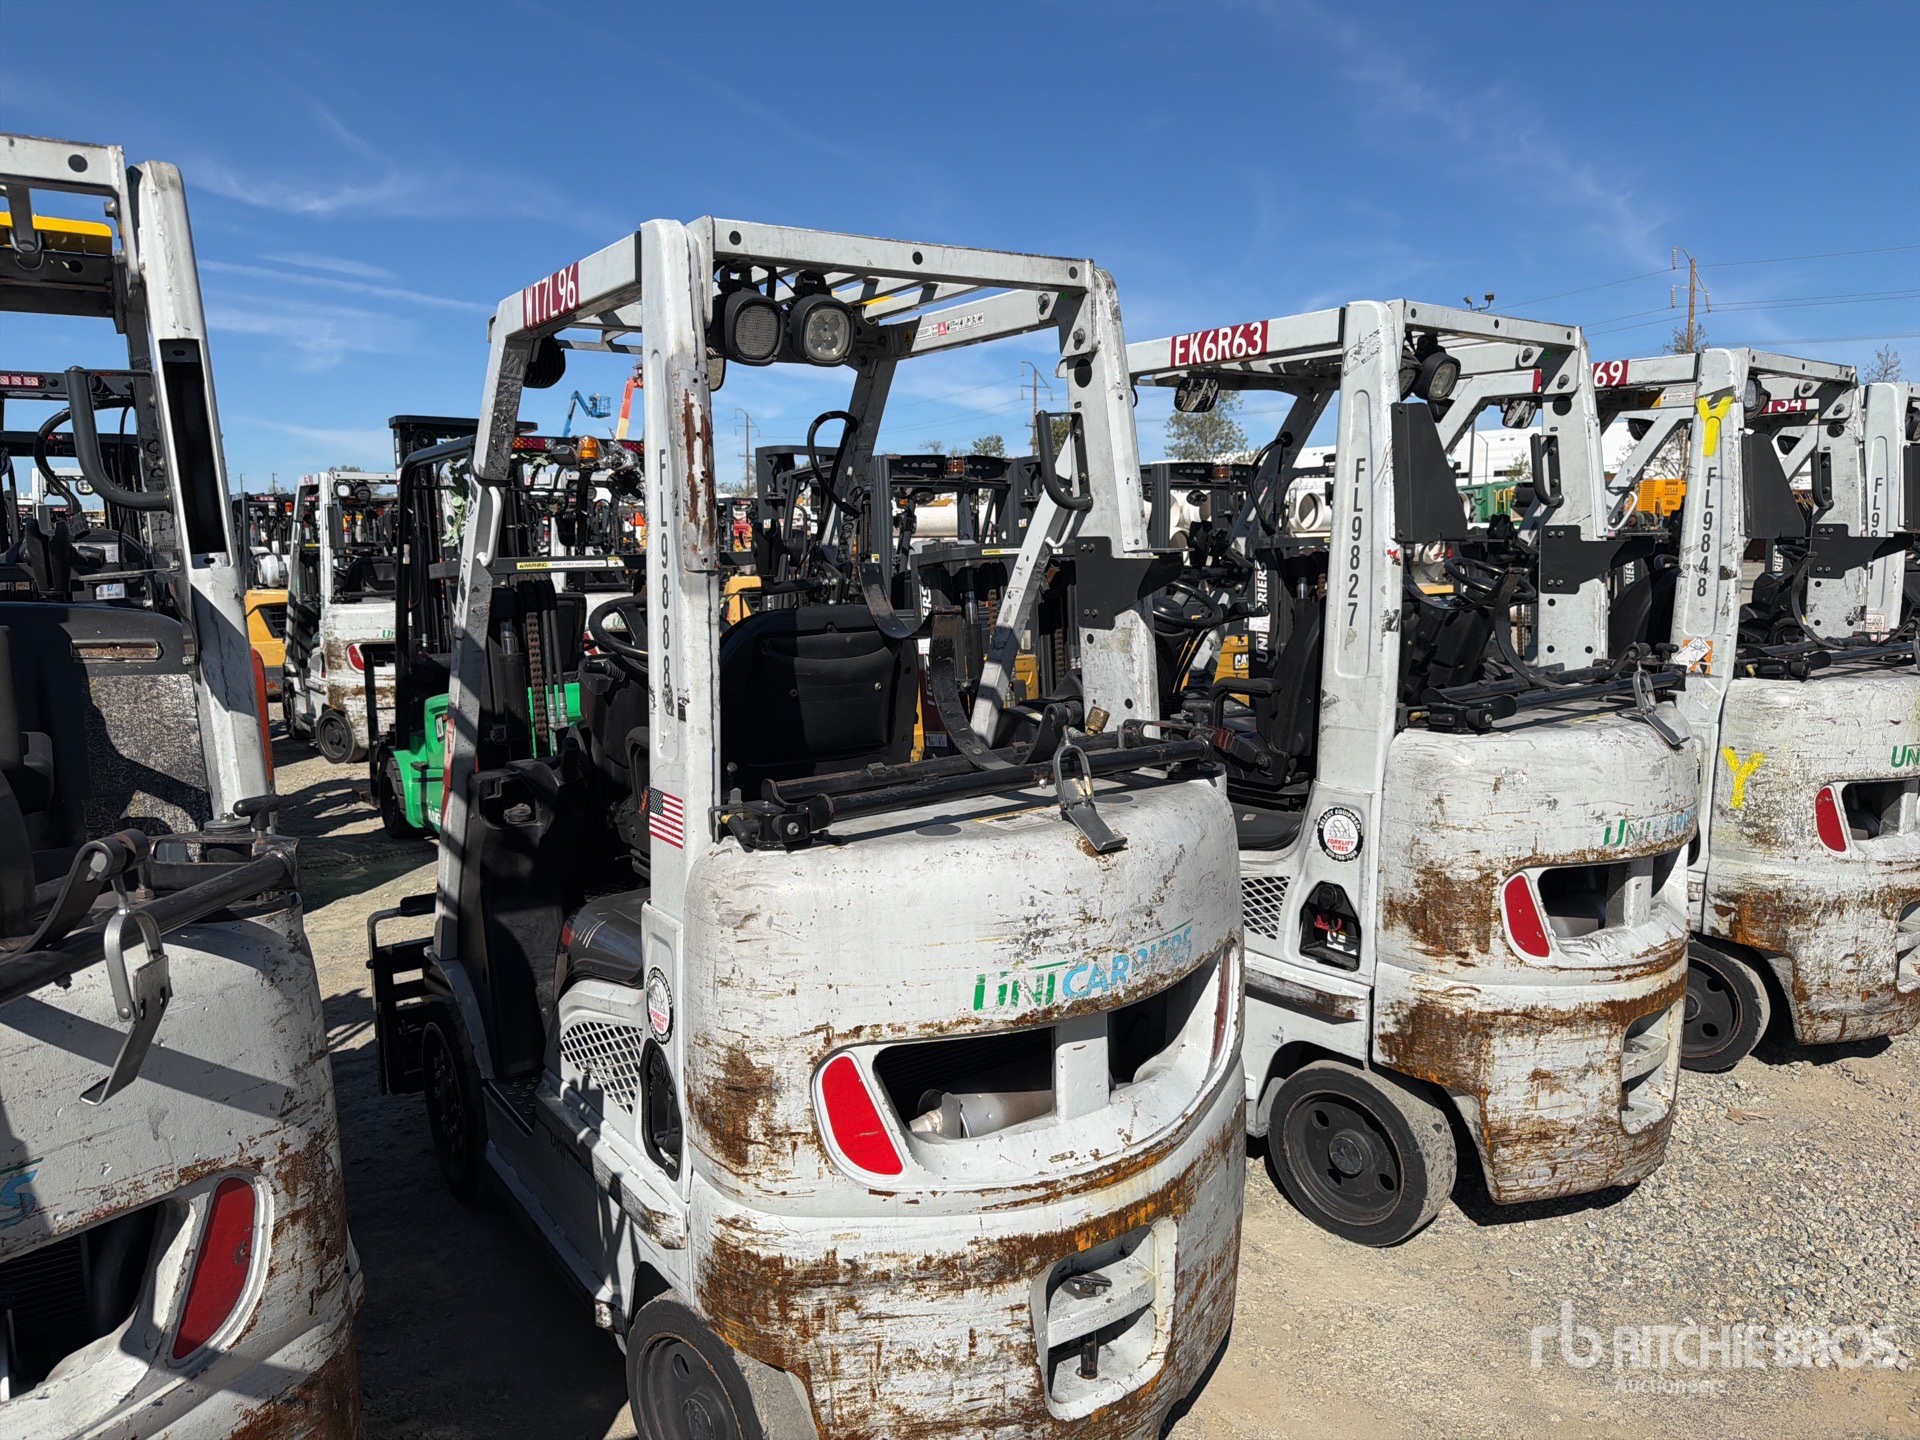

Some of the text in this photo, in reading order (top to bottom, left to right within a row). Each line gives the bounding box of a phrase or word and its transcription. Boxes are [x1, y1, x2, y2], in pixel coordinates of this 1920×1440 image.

[525, 264, 576, 328] WT7L96
[1174, 321, 1263, 366] EK6R63
[1696, 395, 1735, 456] Y
[1347, 457, 1367, 627] FL9827
[1696, 466, 1718, 597] FL9848
[1721, 747, 1764, 809] Y
